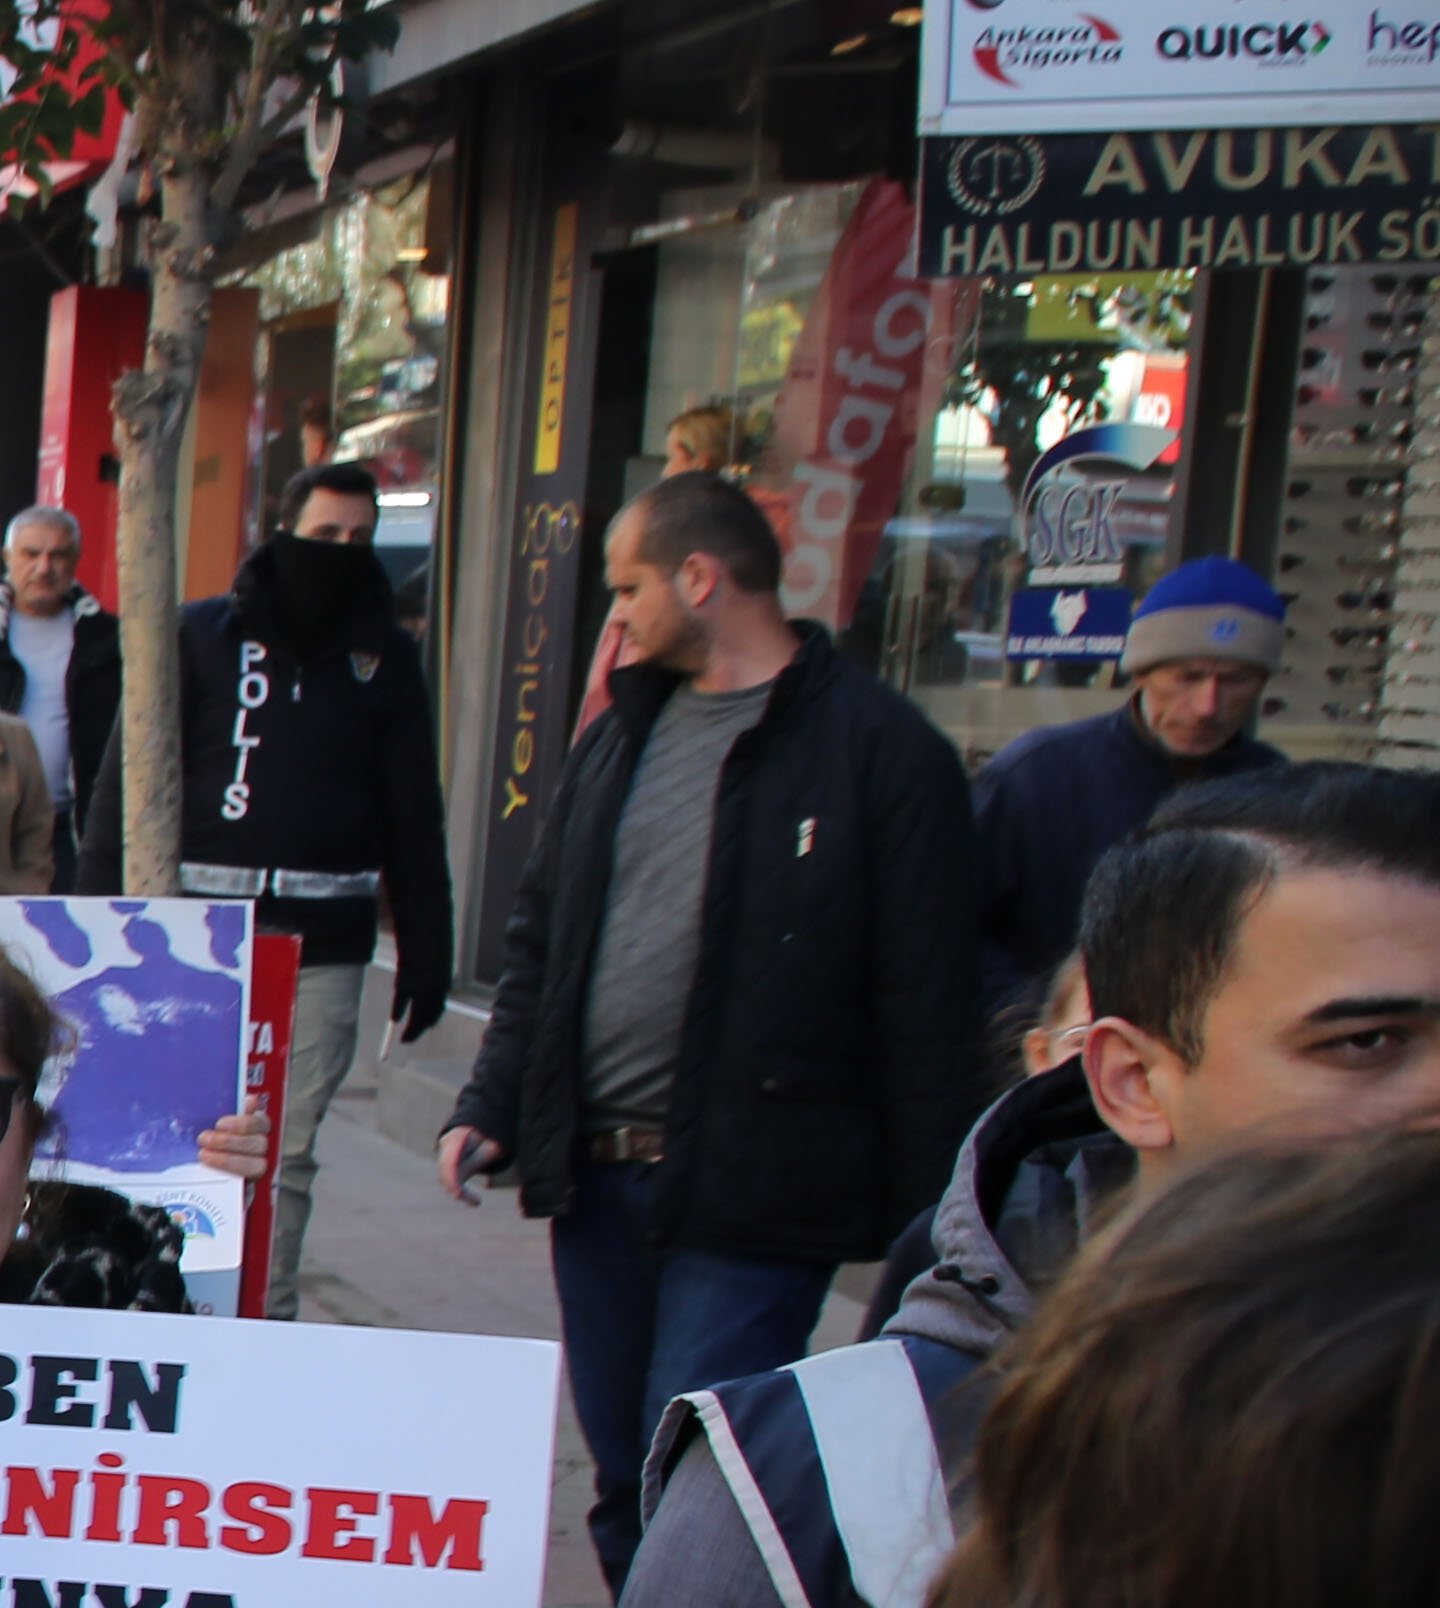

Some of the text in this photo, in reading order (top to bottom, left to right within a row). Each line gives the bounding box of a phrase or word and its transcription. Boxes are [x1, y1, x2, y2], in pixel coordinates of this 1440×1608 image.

[974, 24, 1091, 47] Ankara
[1154, 21, 1312, 61] QUICK
[1005, 43, 1125, 72] Sigorta
[941, 217, 1163, 275] HALDUN
[1181, 211, 1366, 268] HALUK
[1029, 480, 1127, 566] SGK
